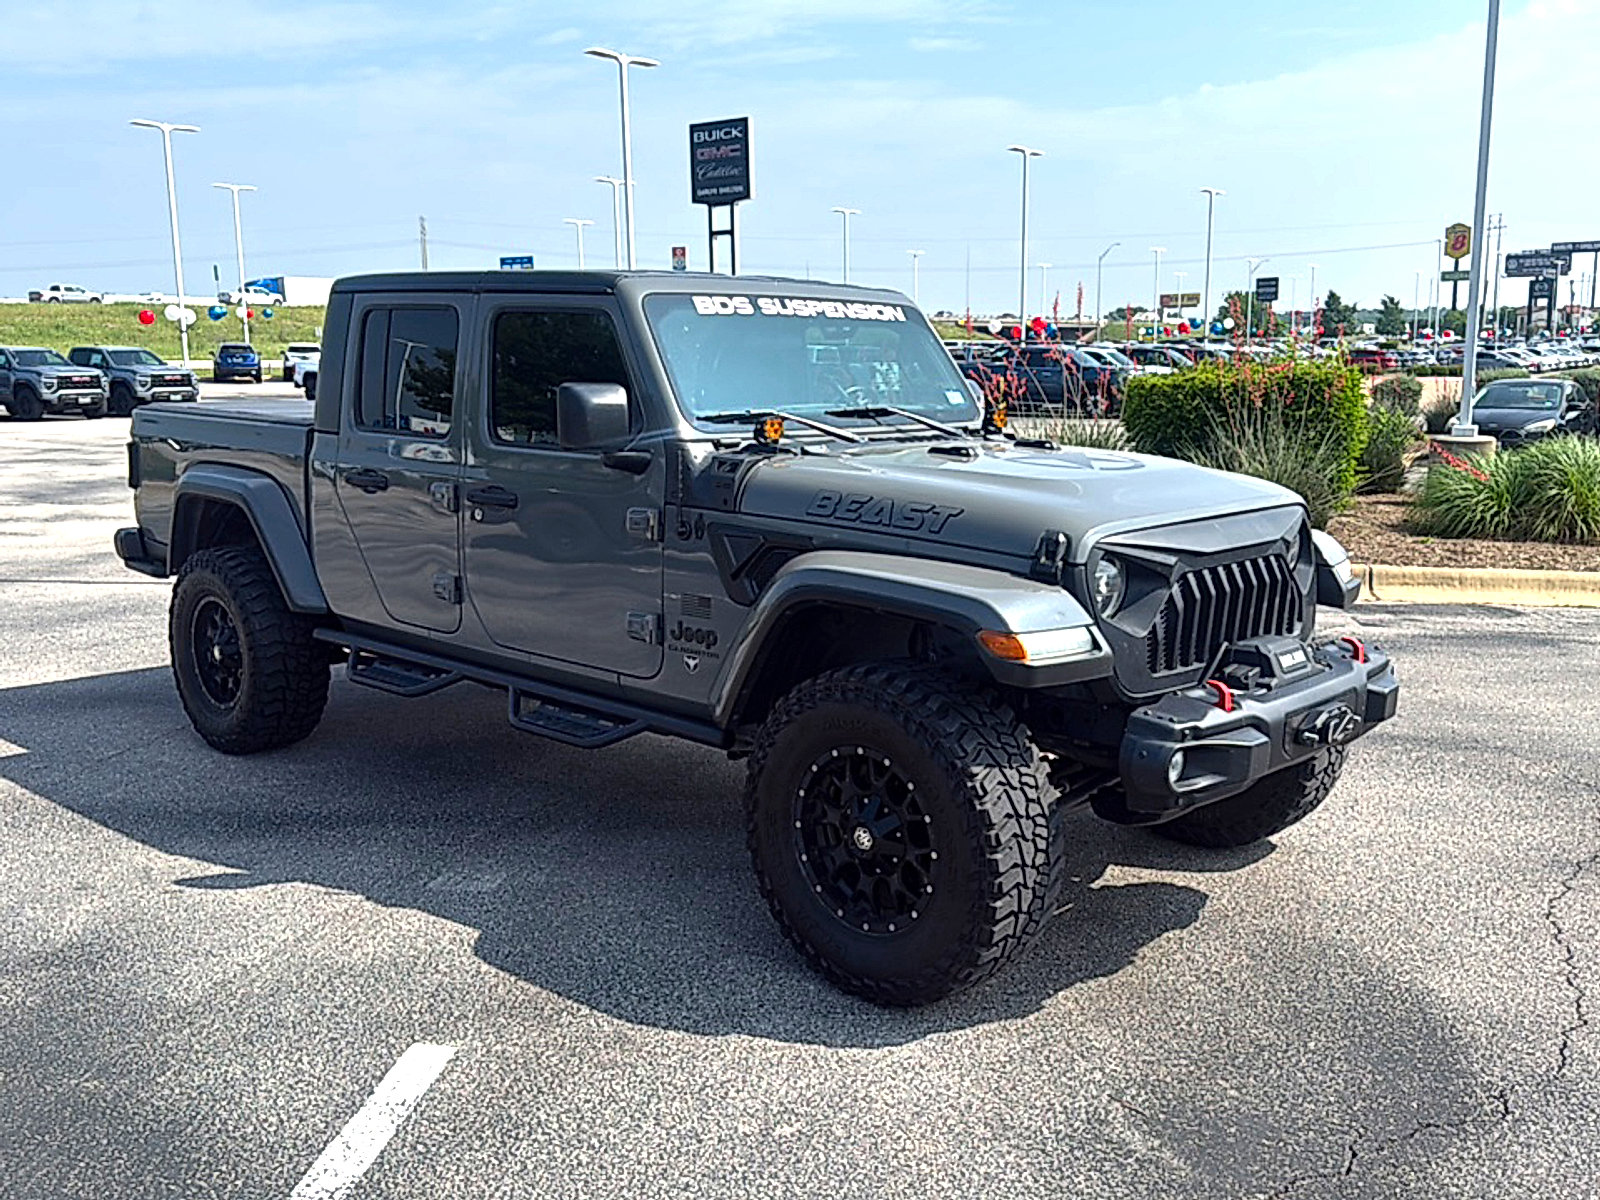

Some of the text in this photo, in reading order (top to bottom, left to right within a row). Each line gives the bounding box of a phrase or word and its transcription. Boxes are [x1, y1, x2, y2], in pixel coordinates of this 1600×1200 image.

[693, 127, 743, 143] BUICK
[696, 144, 741, 160] GMC
[1452, 234, 1467, 251] 8
[692, 296, 906, 322] BDS SUSPENSION
[806, 489, 964, 534] BEAST
[670, 620, 718, 650] Jeep
